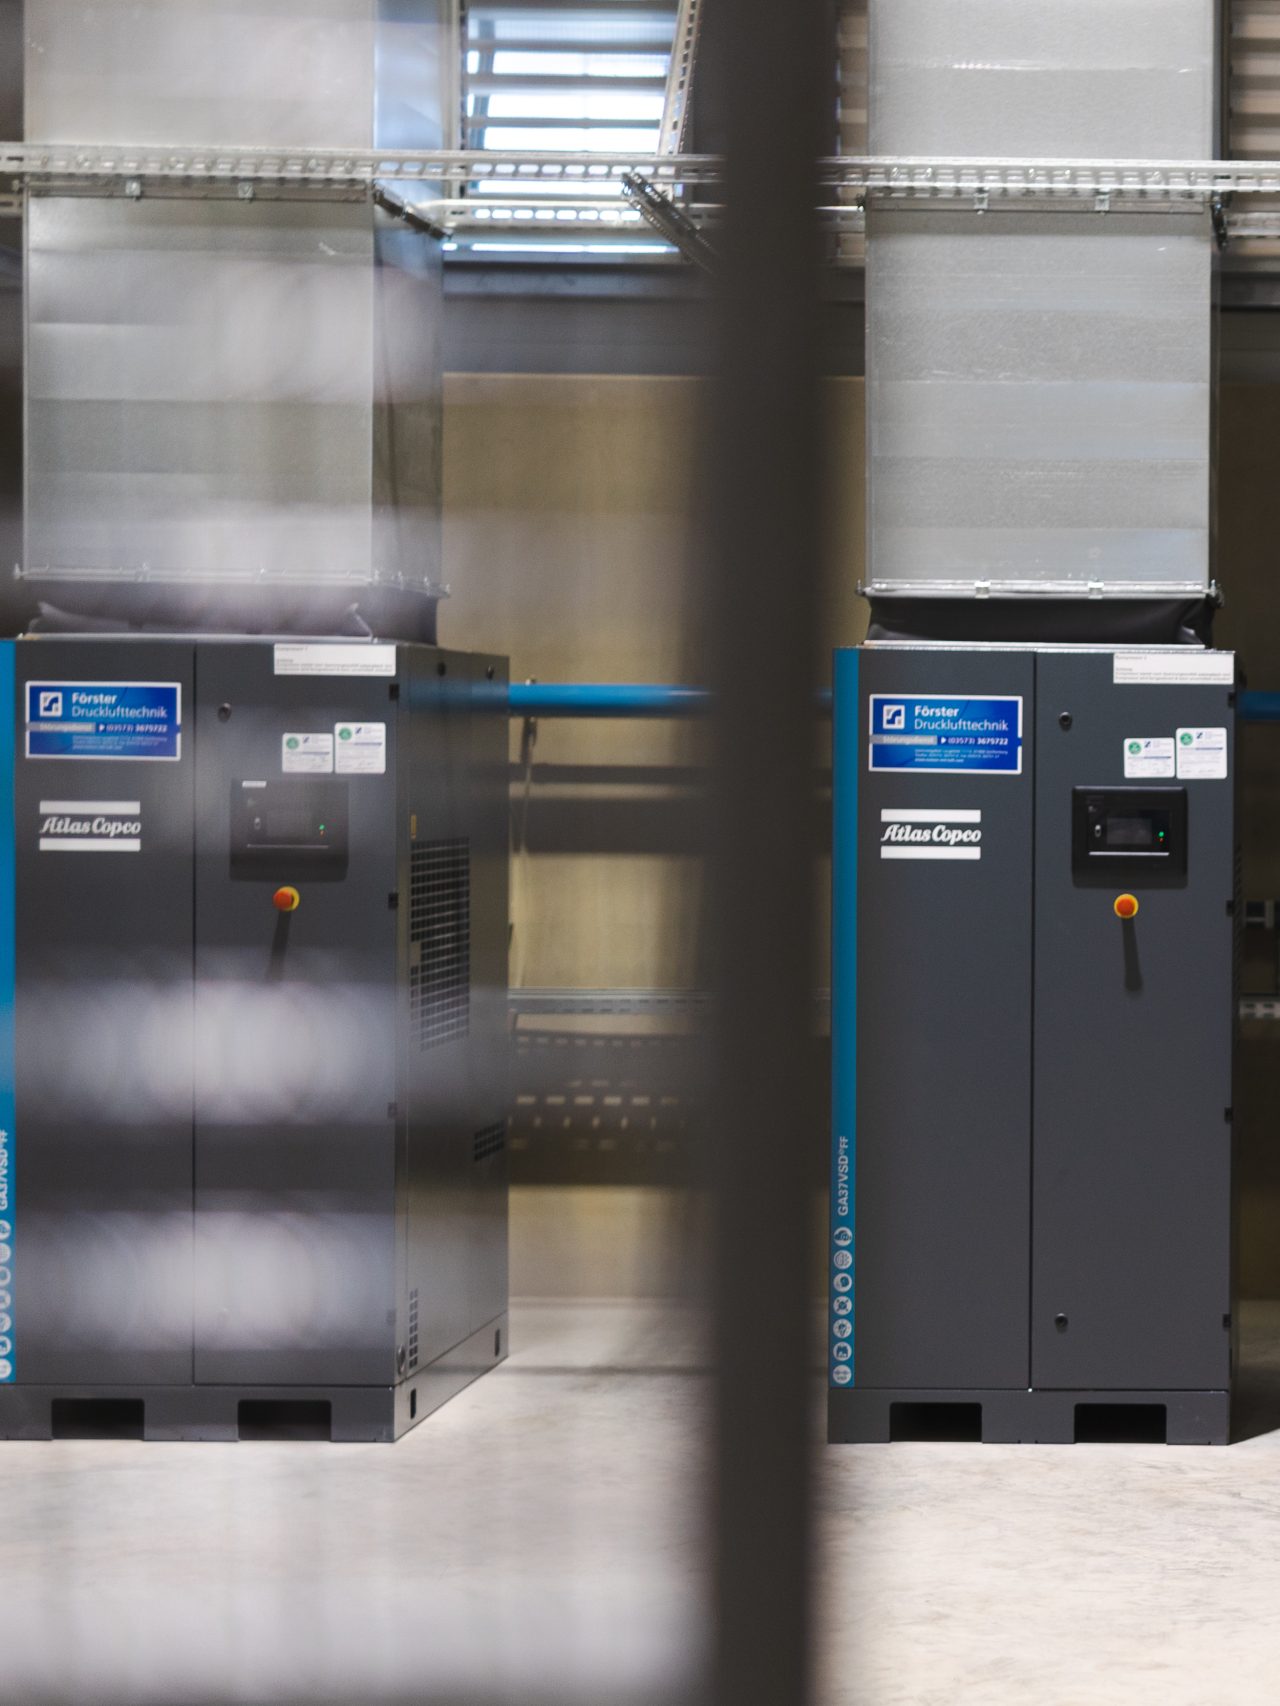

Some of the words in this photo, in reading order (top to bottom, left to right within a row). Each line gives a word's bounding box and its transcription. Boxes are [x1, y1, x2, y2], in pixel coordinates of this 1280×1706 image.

[72, 692, 117, 704] Förster
[72, 705, 168, 719] Drucklufttechnik
[914, 704, 959, 717] Förster
[914, 718, 1008, 731] Drucklufttechnik
[40, 817, 91, 834] Atlas
[91, 817, 142, 837] Copco
[881, 824, 932, 843] Atlas
[932, 824, 982, 845] Copco
